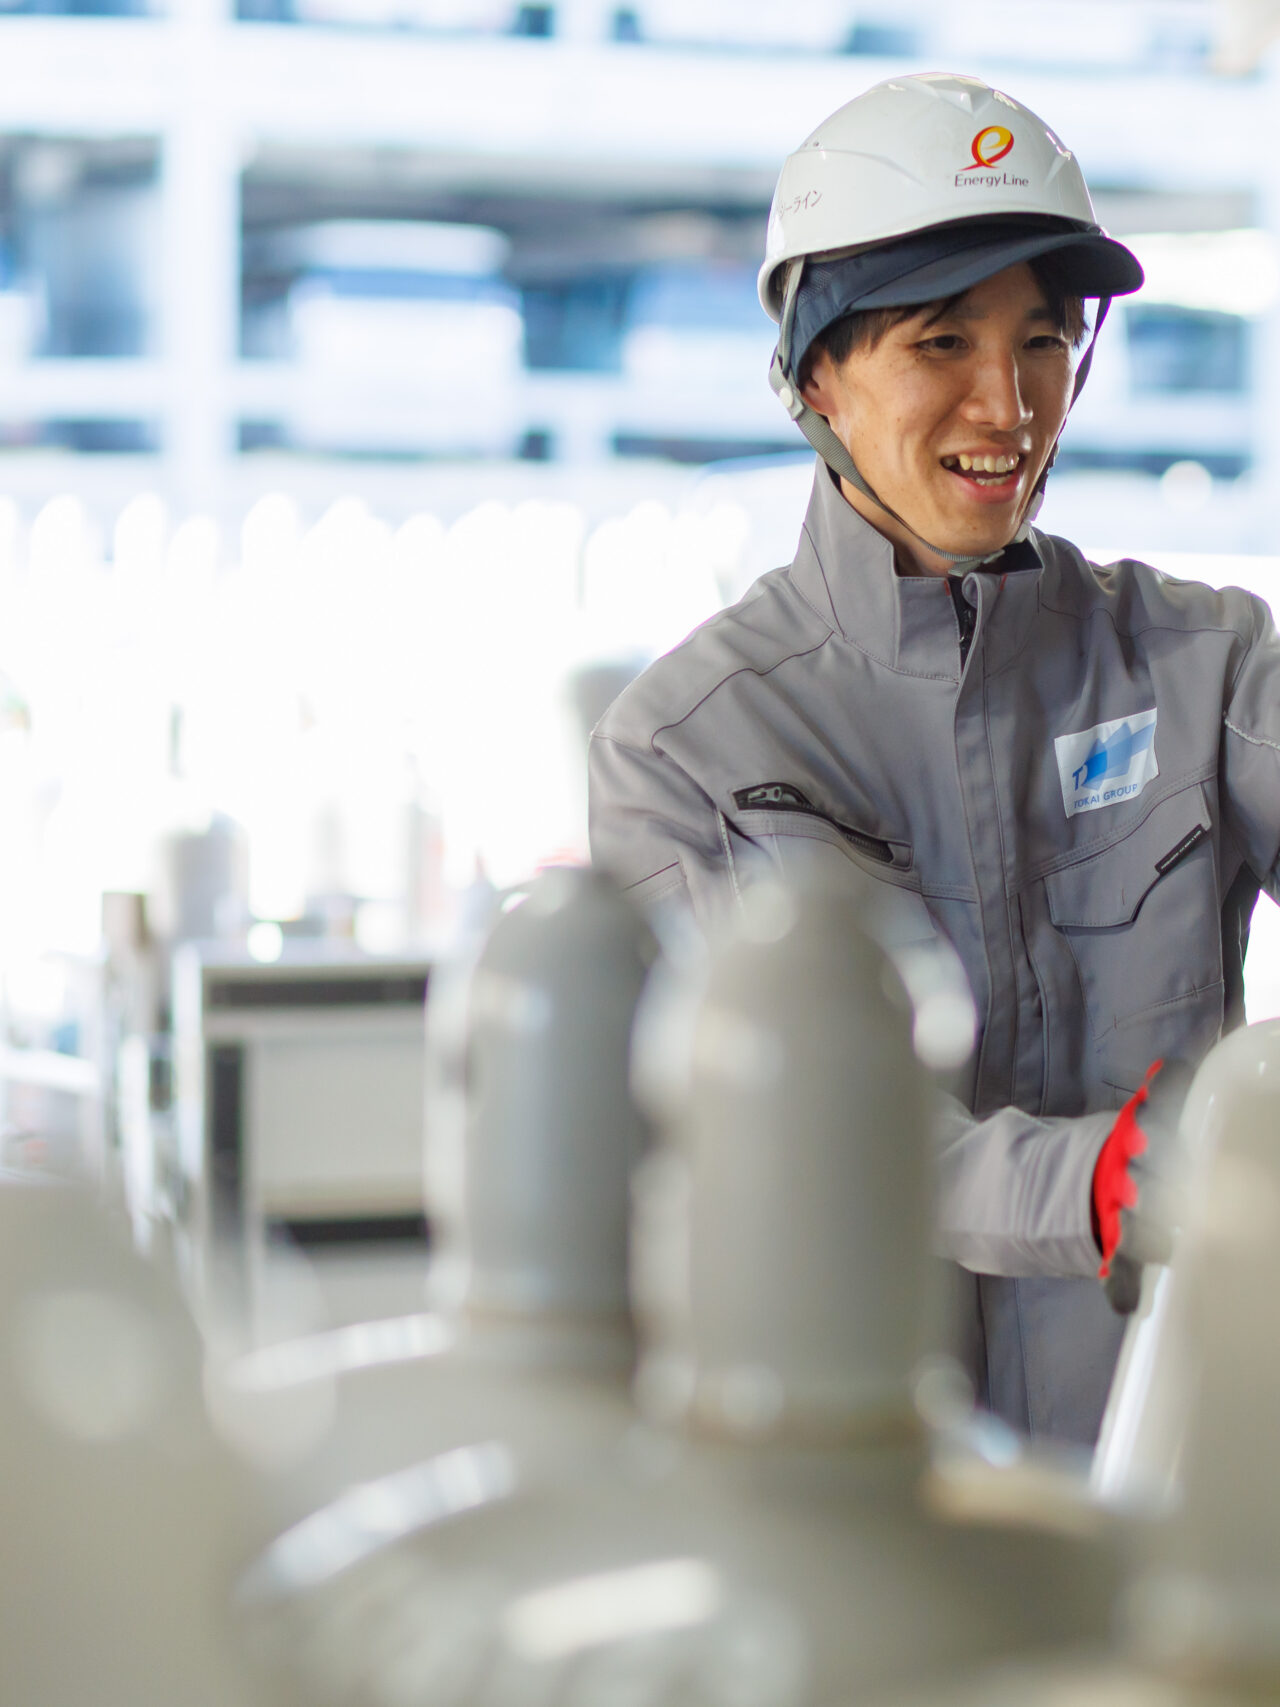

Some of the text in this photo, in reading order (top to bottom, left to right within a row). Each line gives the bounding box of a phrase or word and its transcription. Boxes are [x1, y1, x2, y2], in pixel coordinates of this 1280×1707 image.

[954, 172, 1030, 187] Energy Line
[1074, 784, 1138, 809] TOKAI GROUP
